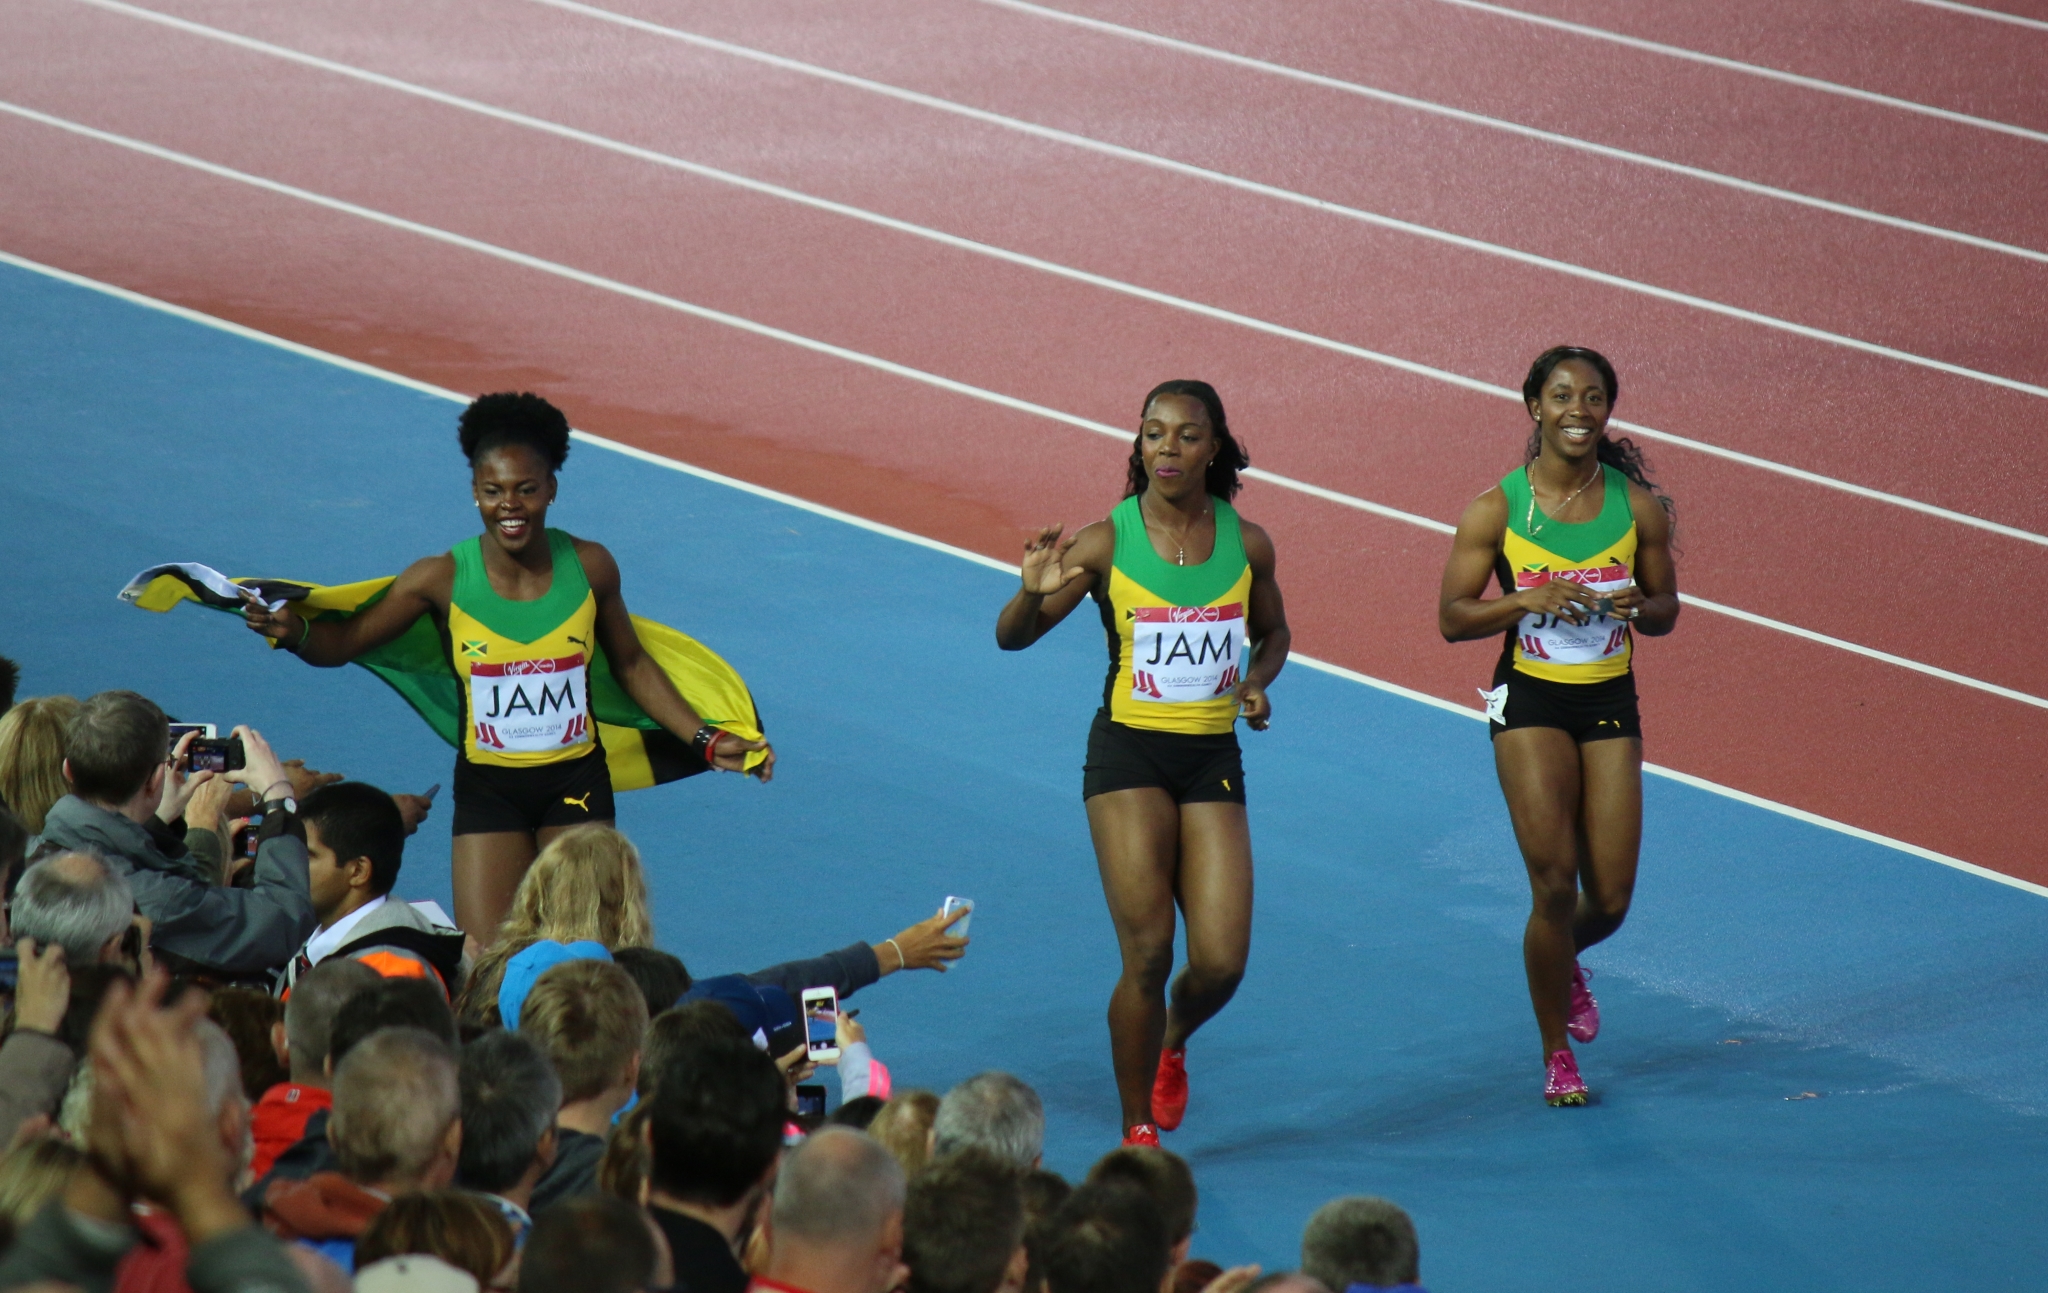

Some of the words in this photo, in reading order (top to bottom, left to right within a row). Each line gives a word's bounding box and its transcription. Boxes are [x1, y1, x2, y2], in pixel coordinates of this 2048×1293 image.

[1146, 629, 1231, 665] JAM
[1547, 637, 1588, 646] GLASGOW
[508, 661, 530, 676] Virgin
[1161, 676, 1201, 684] GLASGOW
[1203, 674, 1218, 683] 2014
[486, 678, 576, 717] JAM
[501, 726, 544, 735] GLASGOW
[545, 723, 562, 732] 2014
